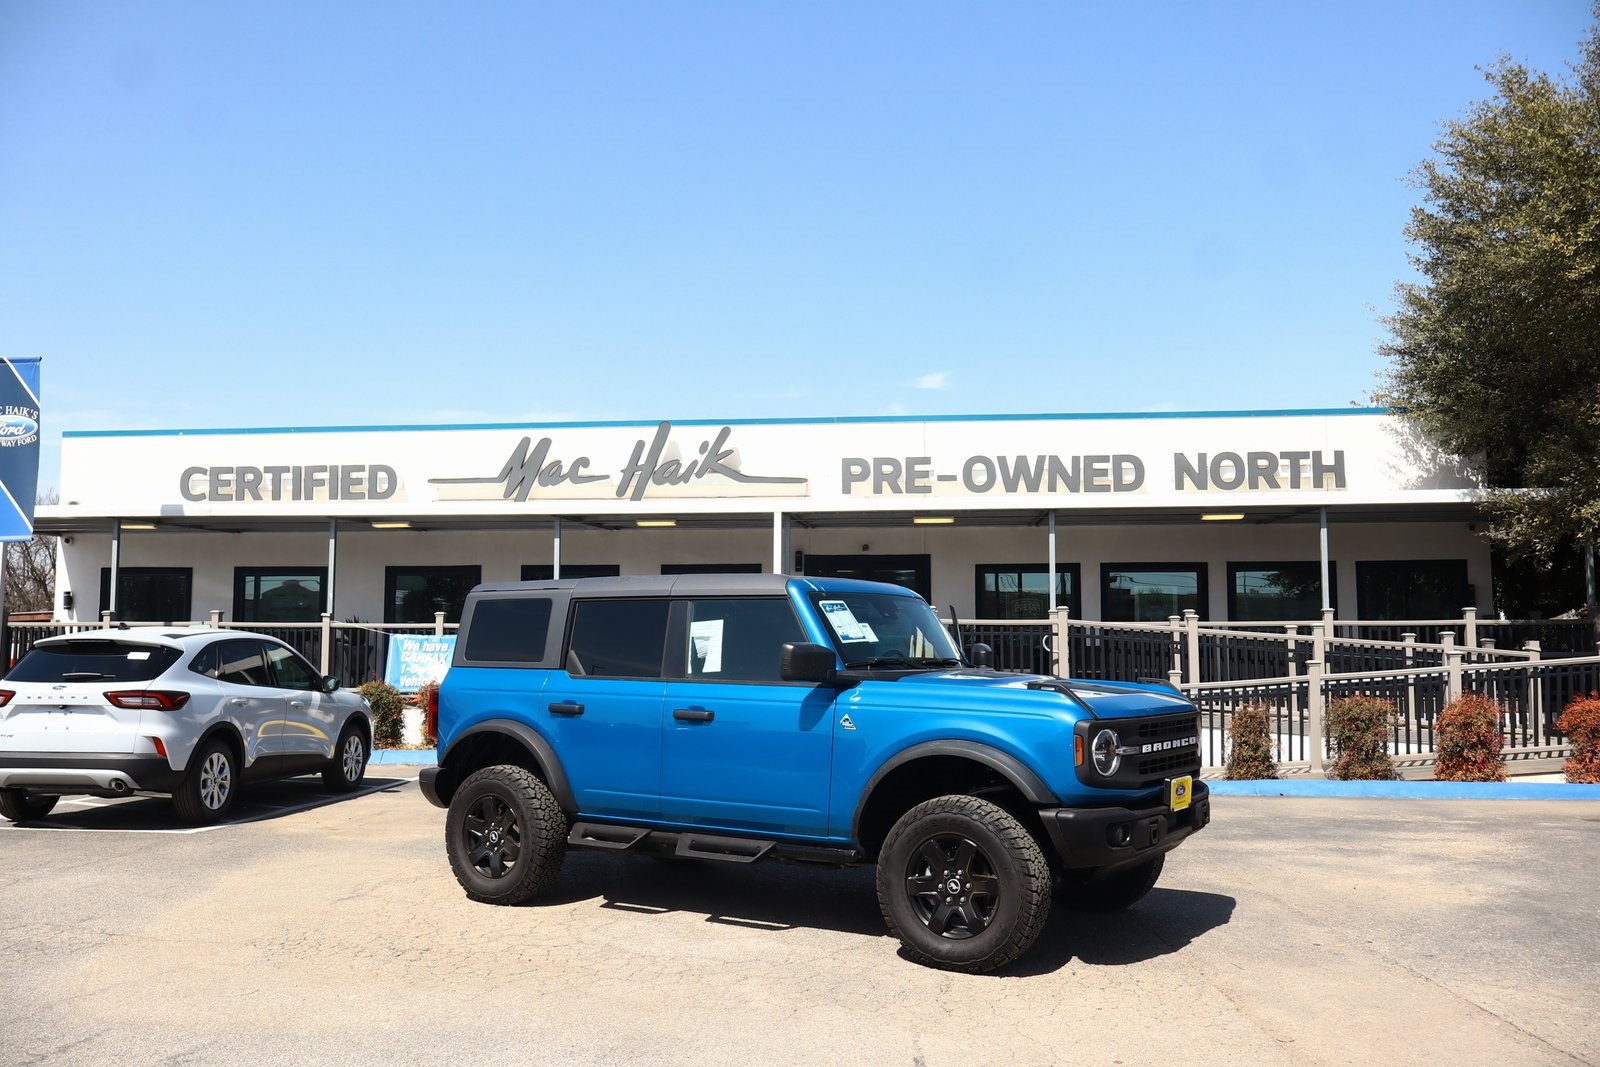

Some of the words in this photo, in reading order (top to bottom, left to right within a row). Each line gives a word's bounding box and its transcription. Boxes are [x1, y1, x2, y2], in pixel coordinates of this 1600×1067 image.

[5, 405, 39, 420] HAIK'S
[17, 434, 37, 447] FORD
[427, 436, 610, 502] Mac
[615, 421, 809, 501] Haik
[841, 454, 1145, 494] PRE-OWNED
[1174, 450, 1346, 491] NORTH
[179, 464, 398, 502] CERTIFIED
[403, 640, 420, 651] We
[423, 641, 448, 652] have
[1142, 736, 1196, 753] BRONCO
